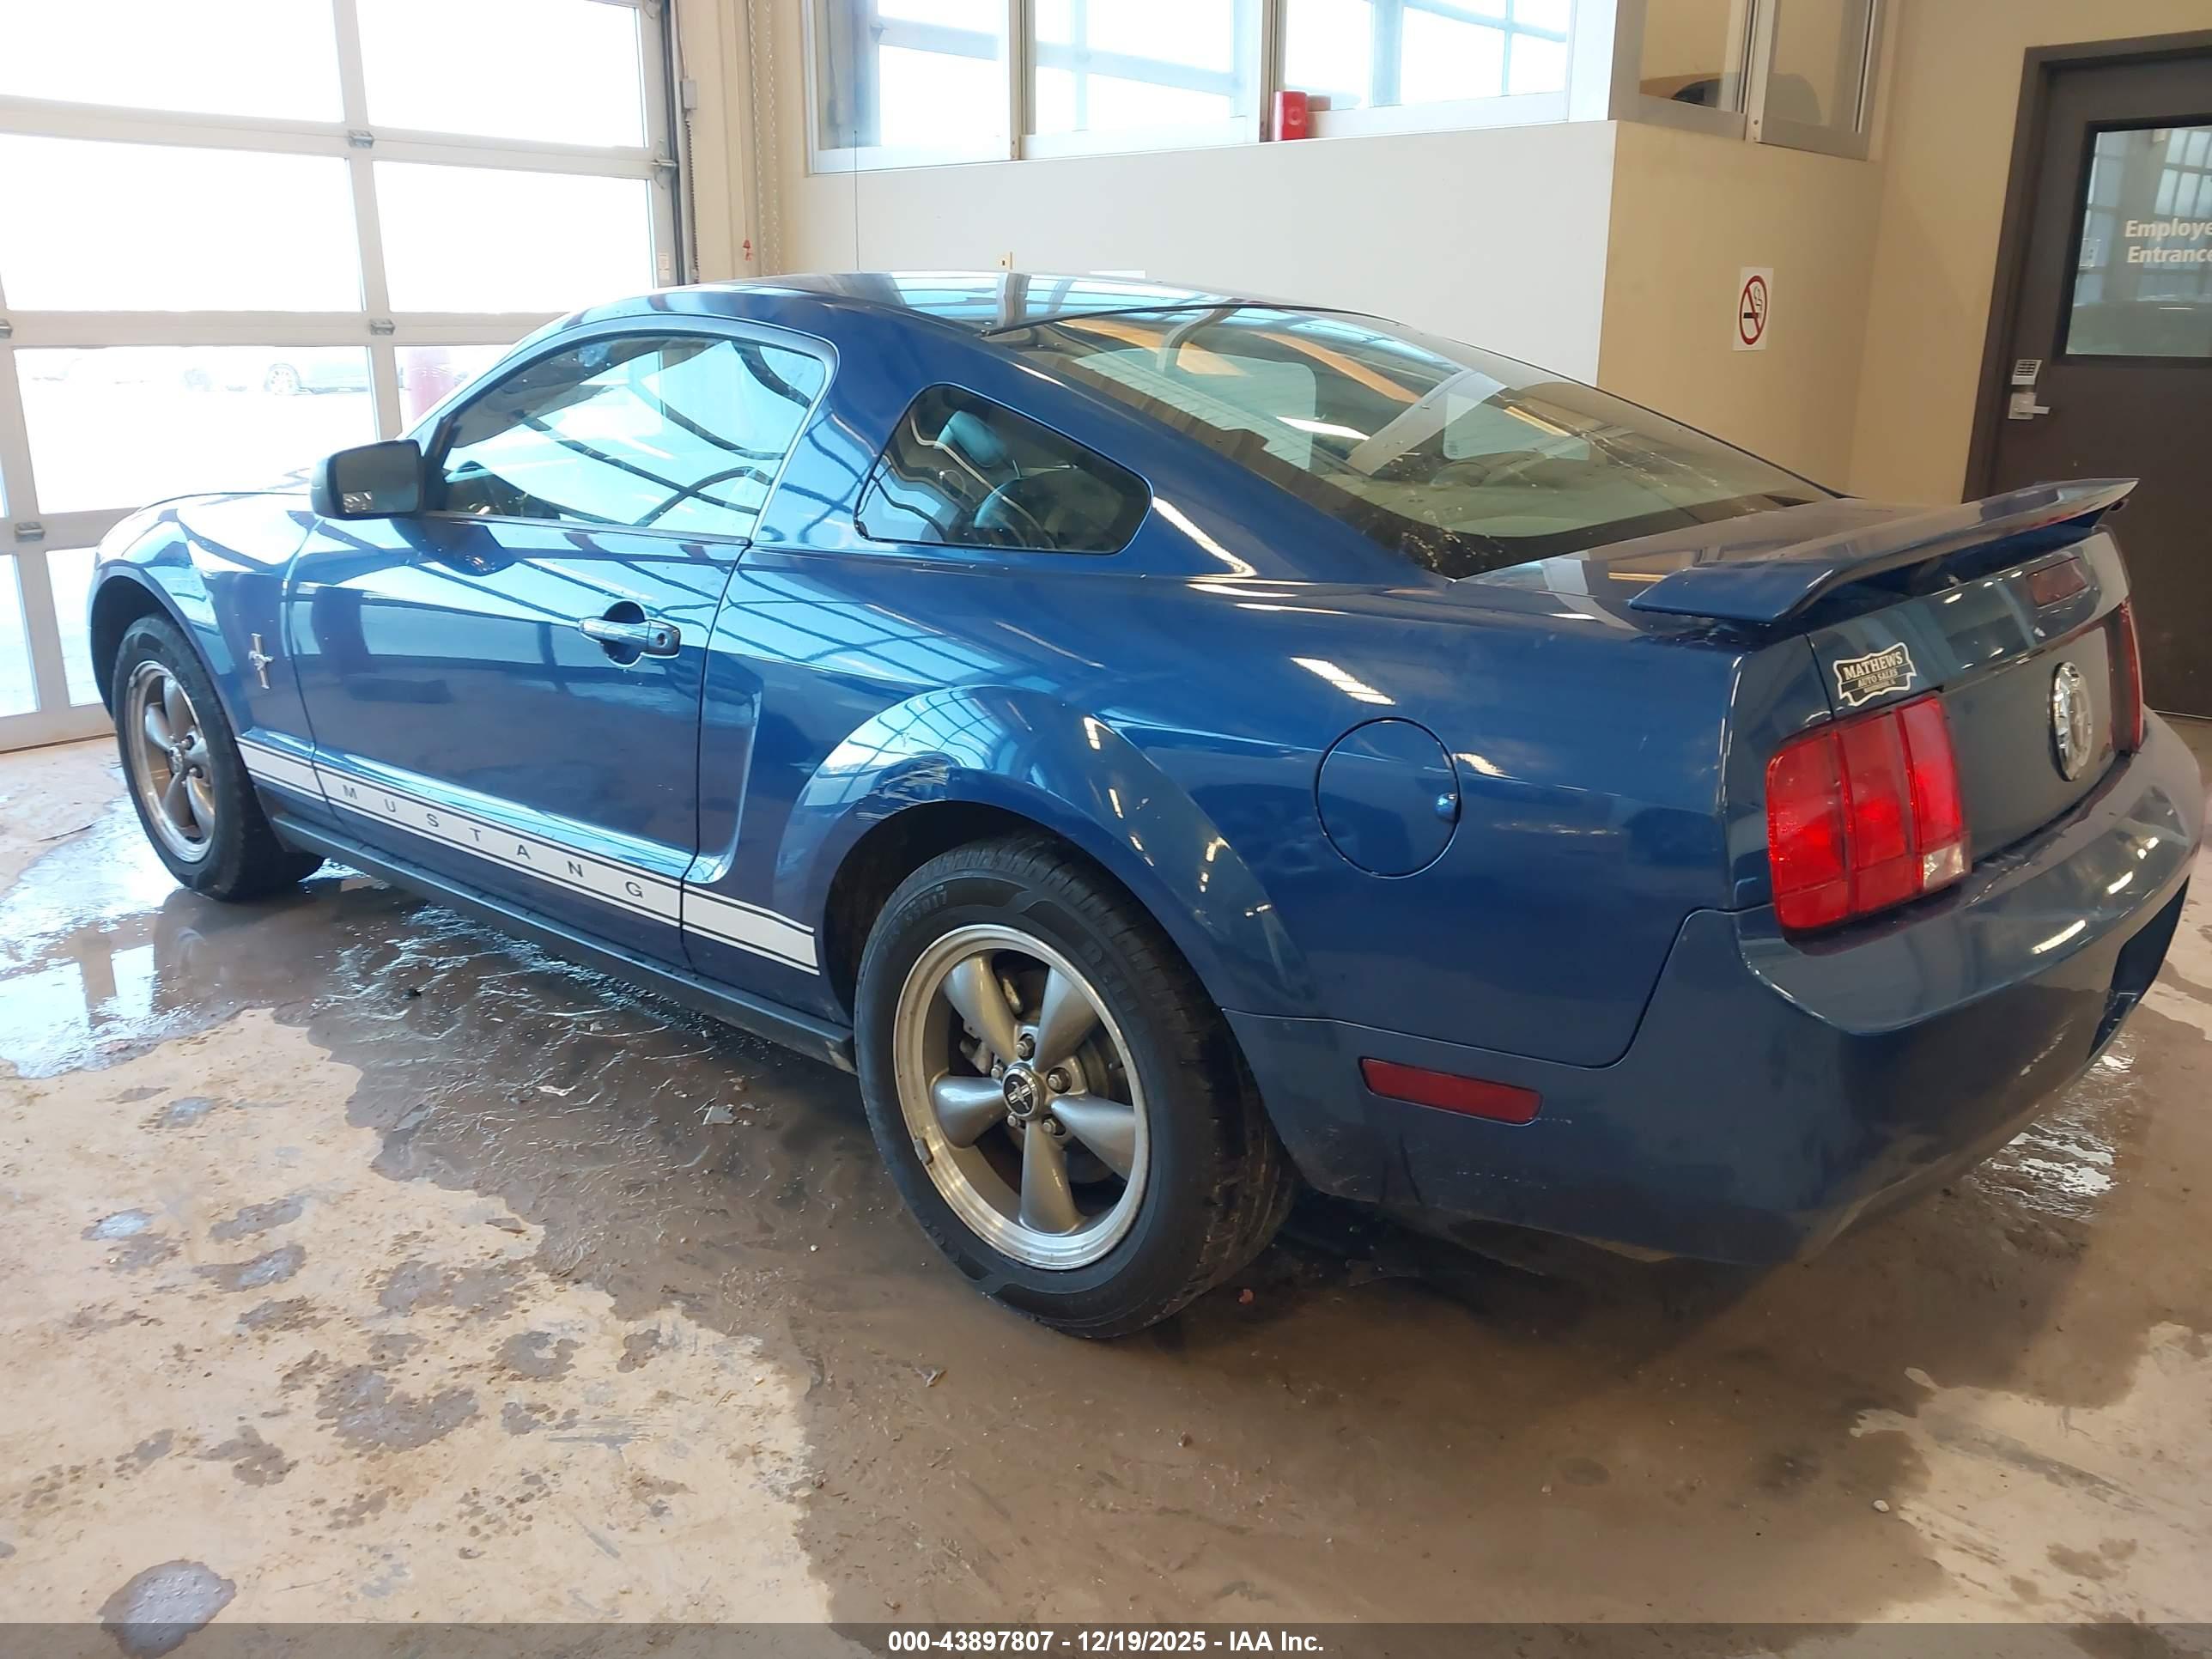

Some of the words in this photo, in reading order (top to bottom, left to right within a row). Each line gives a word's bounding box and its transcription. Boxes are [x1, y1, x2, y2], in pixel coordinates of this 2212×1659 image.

[1843, 651, 1904, 680] MATHEWS
[1857, 674, 1877, 688] AUTO
[1878, 669, 1898, 681] SALES
